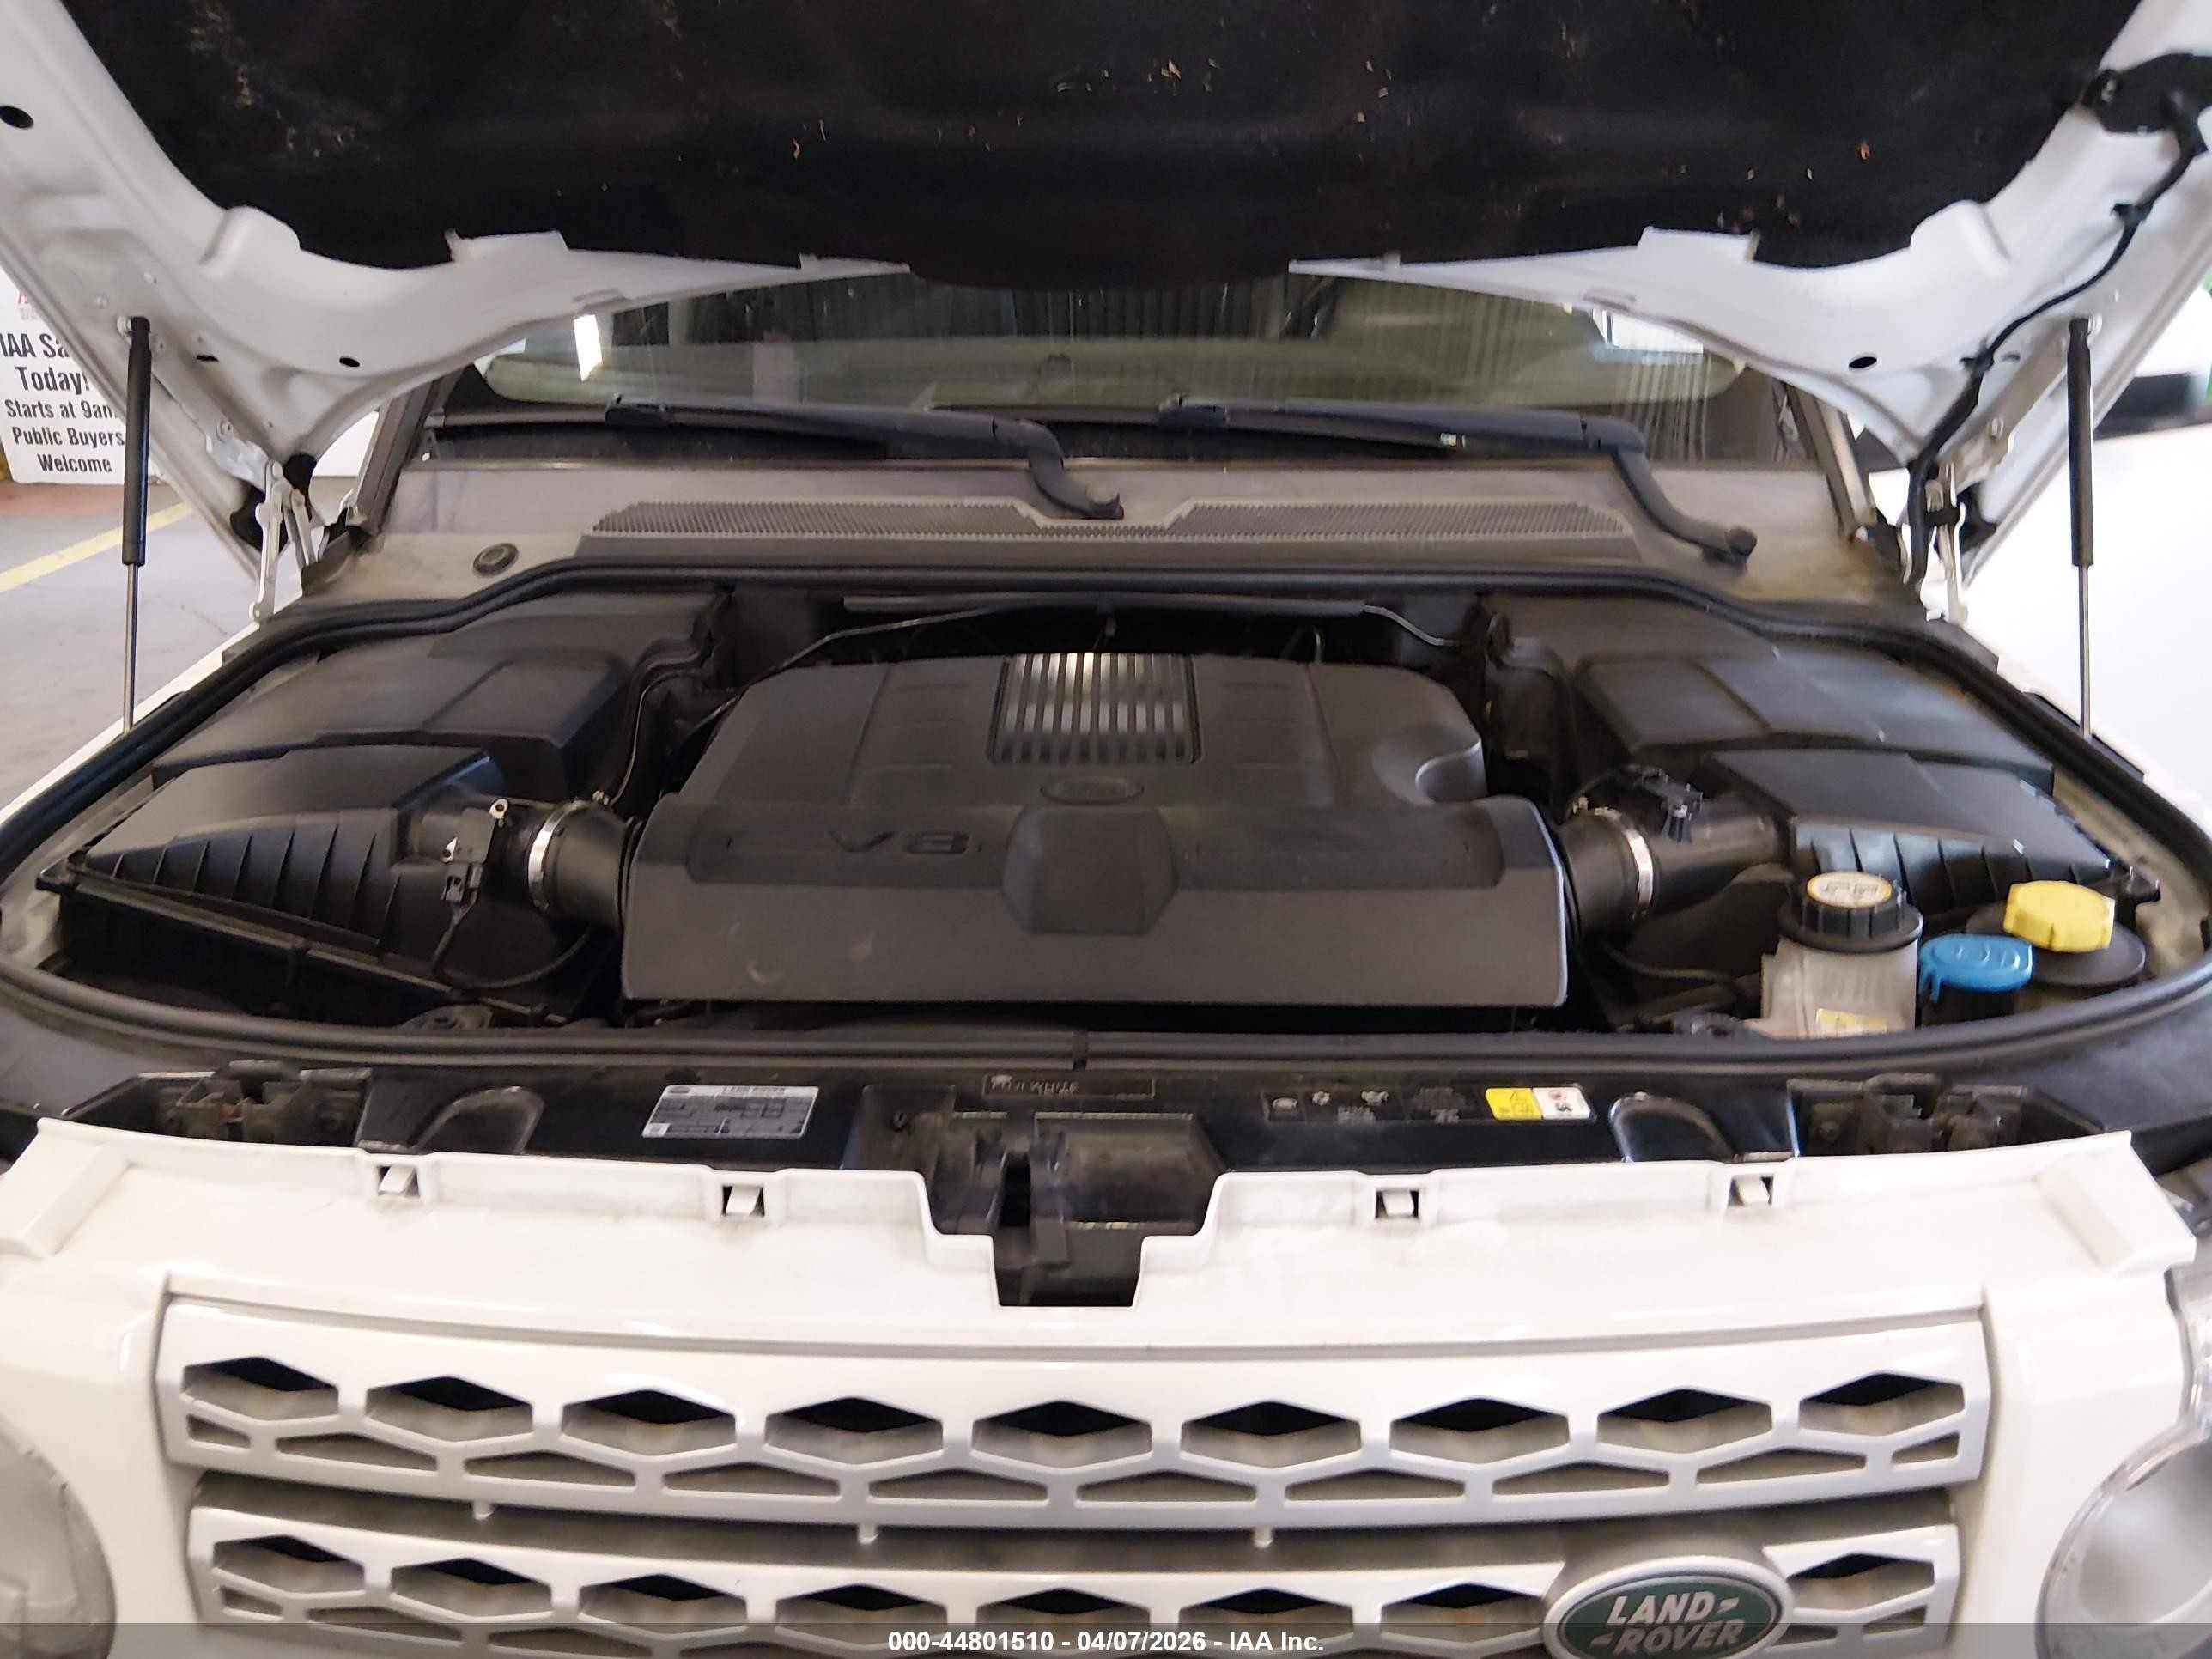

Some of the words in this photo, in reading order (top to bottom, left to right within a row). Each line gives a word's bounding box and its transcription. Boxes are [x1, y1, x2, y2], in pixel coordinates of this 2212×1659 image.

[0, 333, 36, 357] IAA
[40, 333, 70, 358] Sa
[15, 366, 90, 395] Today!
[4, 399, 54, 417] Starts
[59, 401, 76, 418] at
[12, 426, 63, 446] Public
[67, 428, 125, 448] Buyers
[37, 453, 112, 473] Welcome
[824, 829, 971, 855] V8
